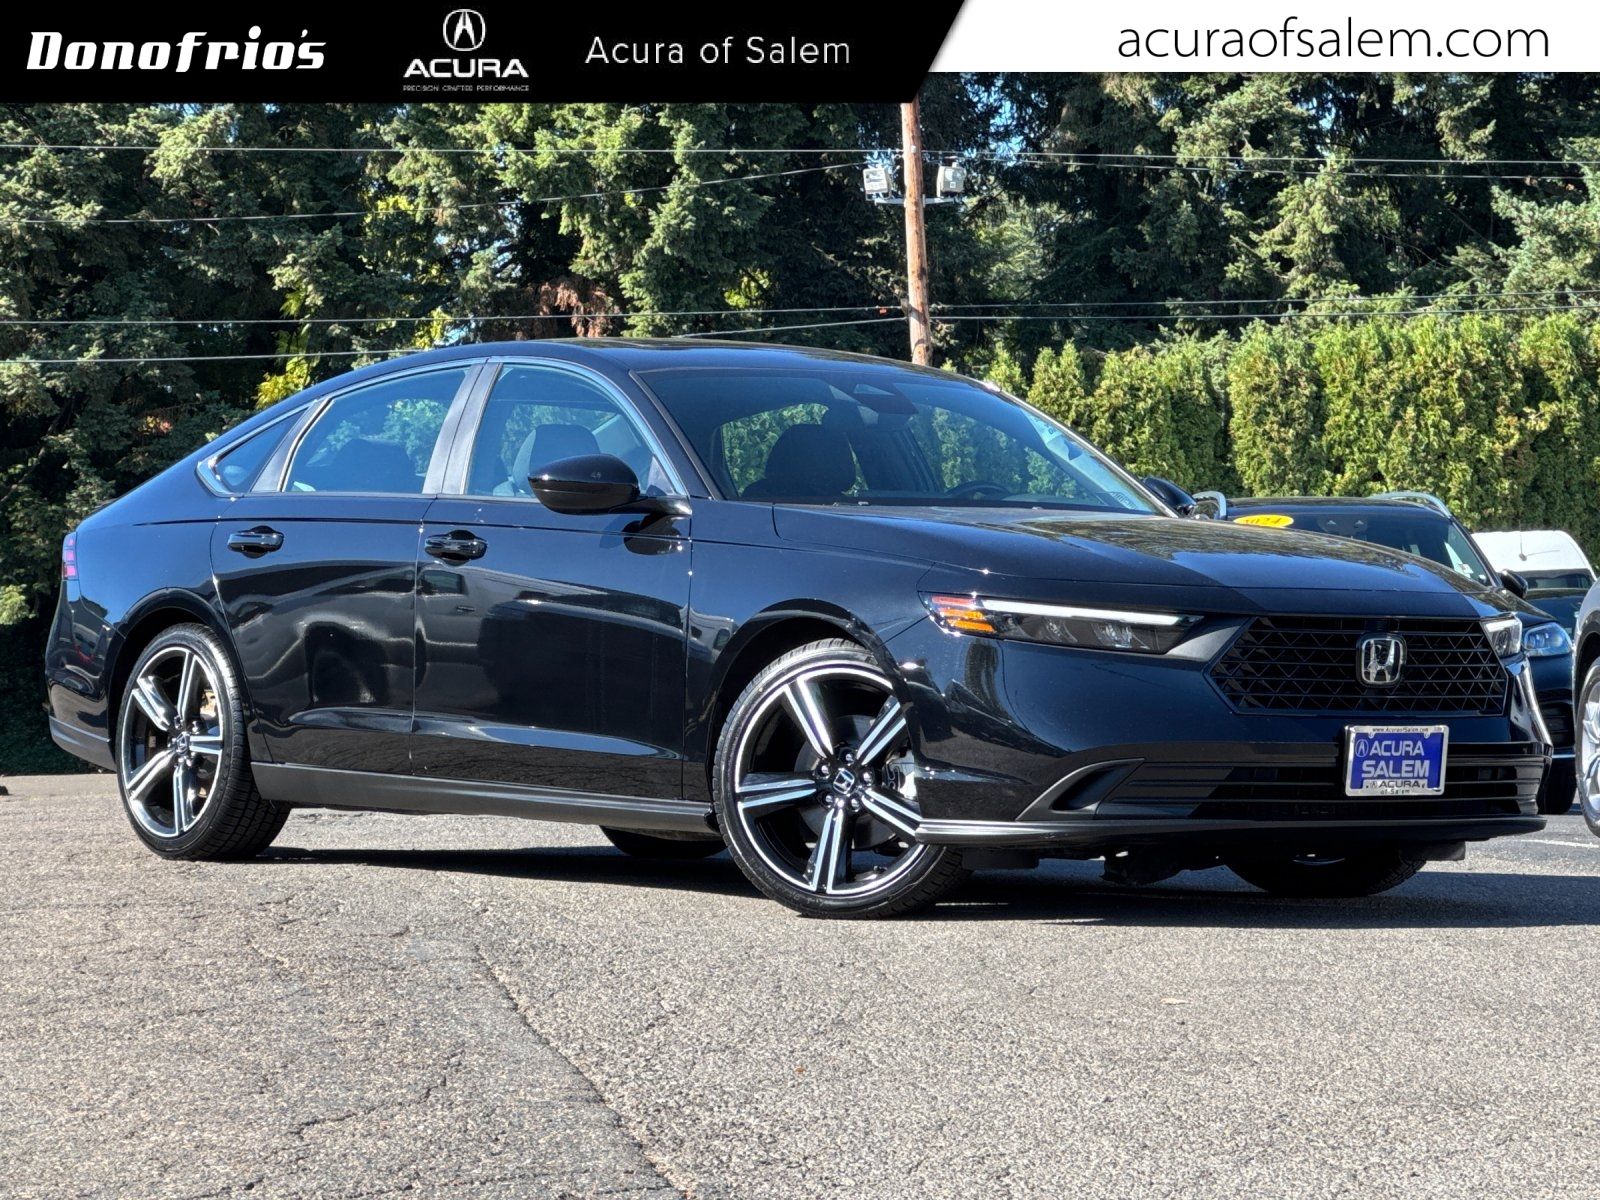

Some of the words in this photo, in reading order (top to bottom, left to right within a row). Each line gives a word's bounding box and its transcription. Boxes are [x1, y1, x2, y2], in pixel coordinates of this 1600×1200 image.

[1369, 740, 1425, 756] ACURA
[1361, 759, 1430, 778] SALEM
[1379, 780, 1420, 789] ACURA
